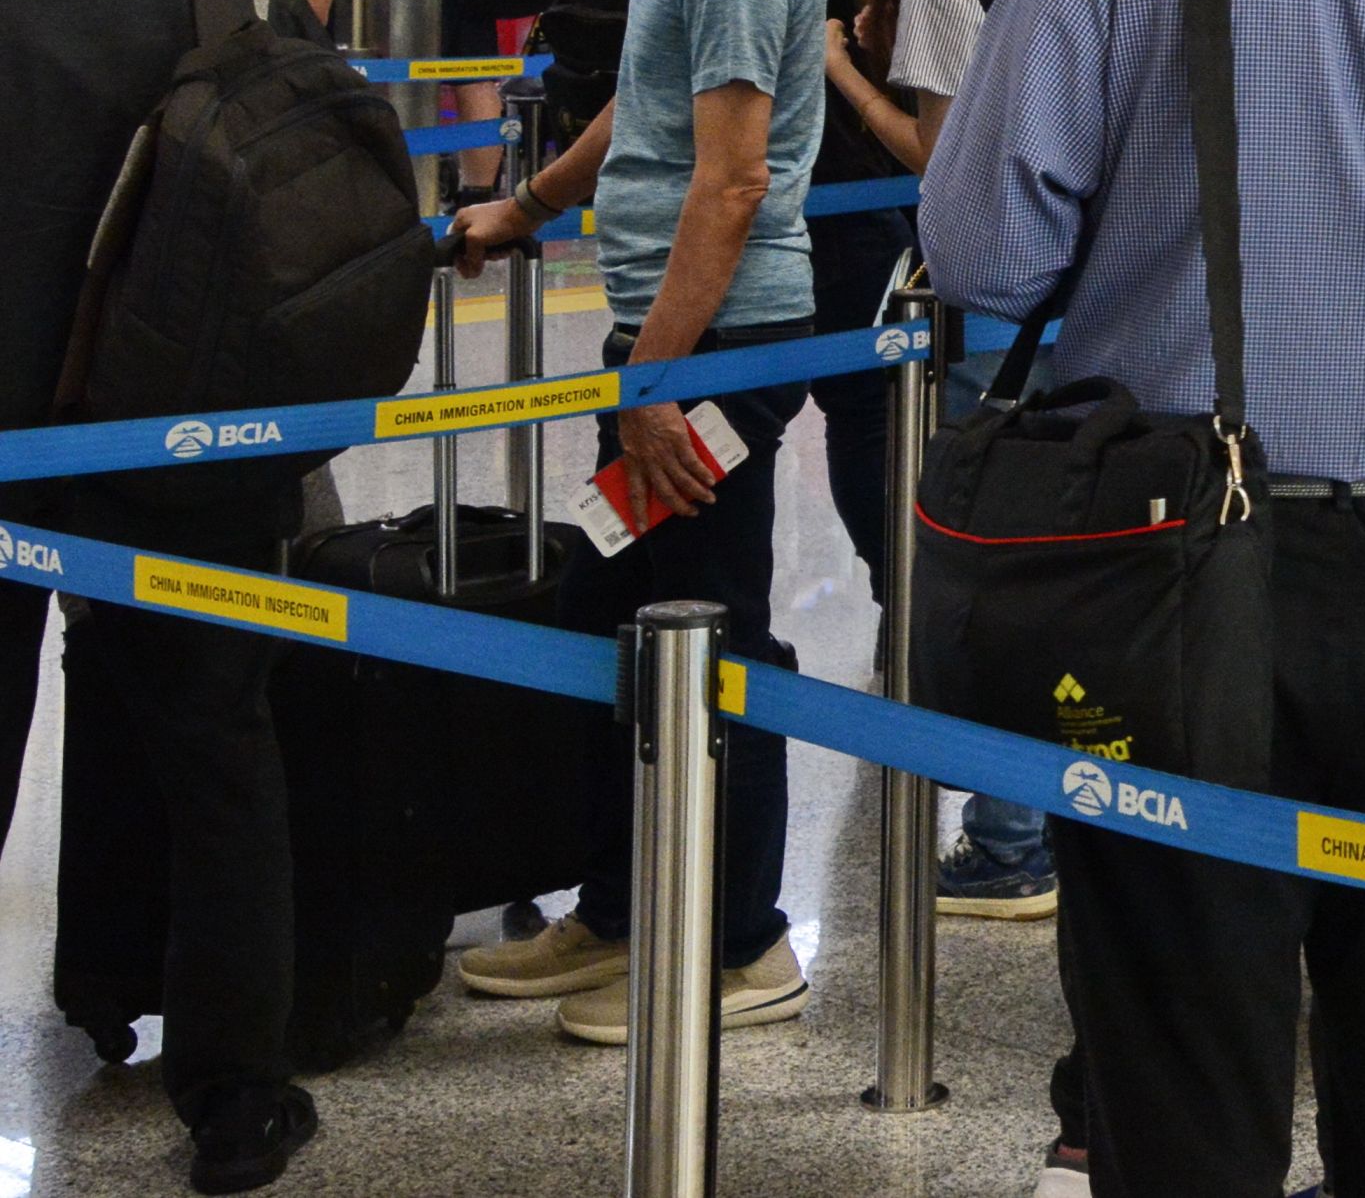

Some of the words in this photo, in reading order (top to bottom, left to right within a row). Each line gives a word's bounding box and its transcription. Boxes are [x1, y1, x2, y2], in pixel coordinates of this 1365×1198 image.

[395, 410, 434, 426] CHINA
[439, 399, 525, 421] IMMIGRATION
[530, 386, 601, 409] INSPECTION
[218, 421, 283, 447] BCIA
[16, 540, 64, 575] BCIA
[150, 575, 182, 593] CHINA
[187, 582, 260, 609] IMMIGRATION
[265, 596, 329, 624] INSPECTION
[1117, 782, 1188, 830] BCIA
